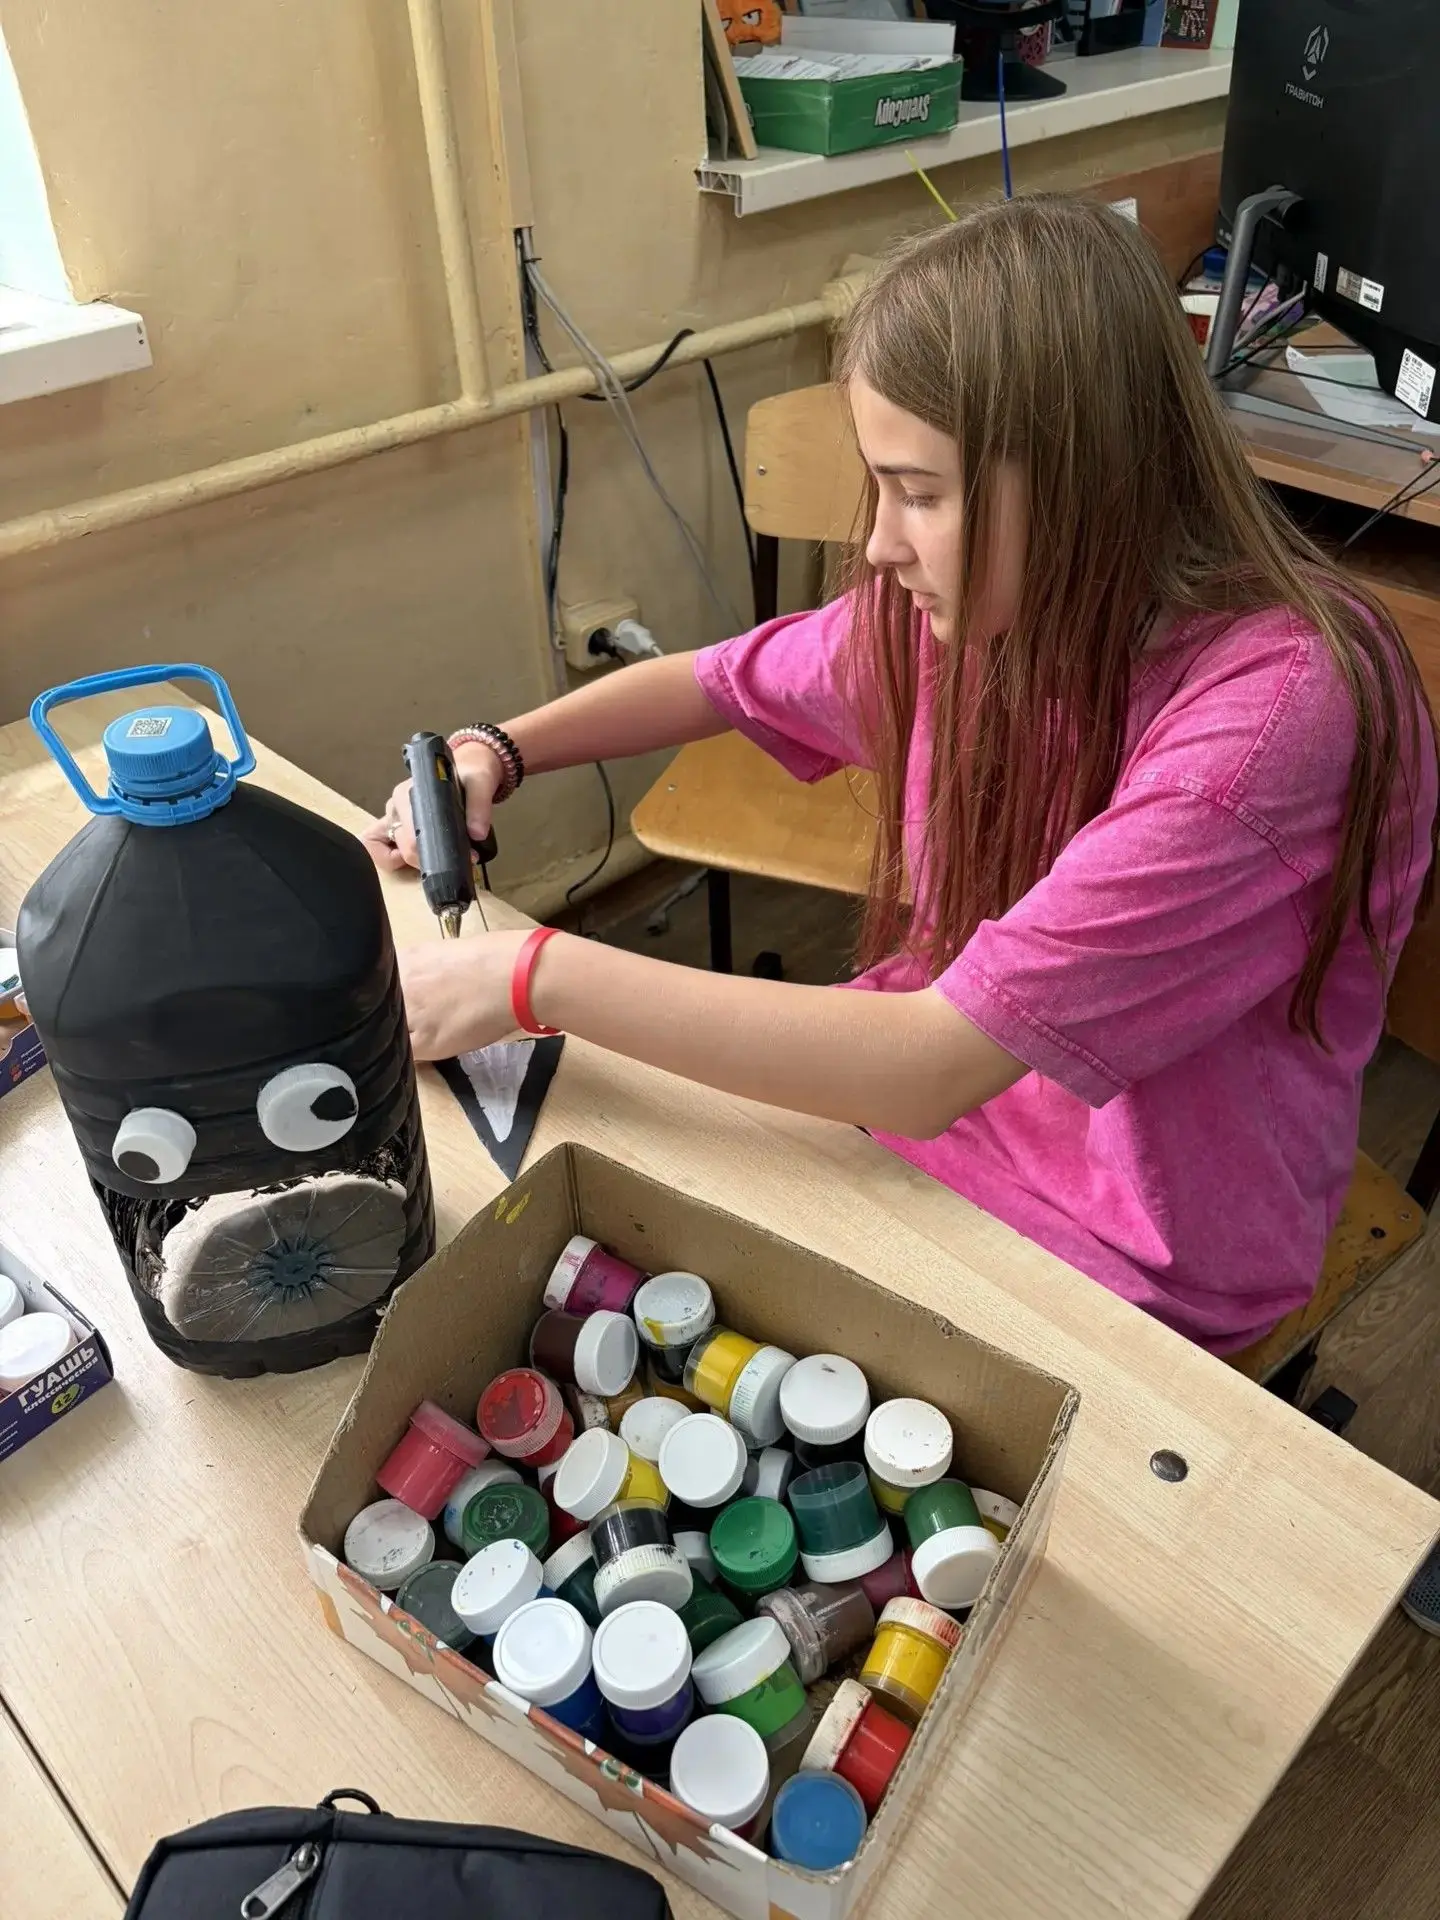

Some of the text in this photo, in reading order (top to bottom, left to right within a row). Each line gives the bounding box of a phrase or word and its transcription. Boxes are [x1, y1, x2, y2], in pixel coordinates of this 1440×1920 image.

[1285, 83, 1324, 108] ГРАВИТОН
[18, 1347, 95, 1408] ГУАШЬ
[54, 1393, 72, 1409] 12
